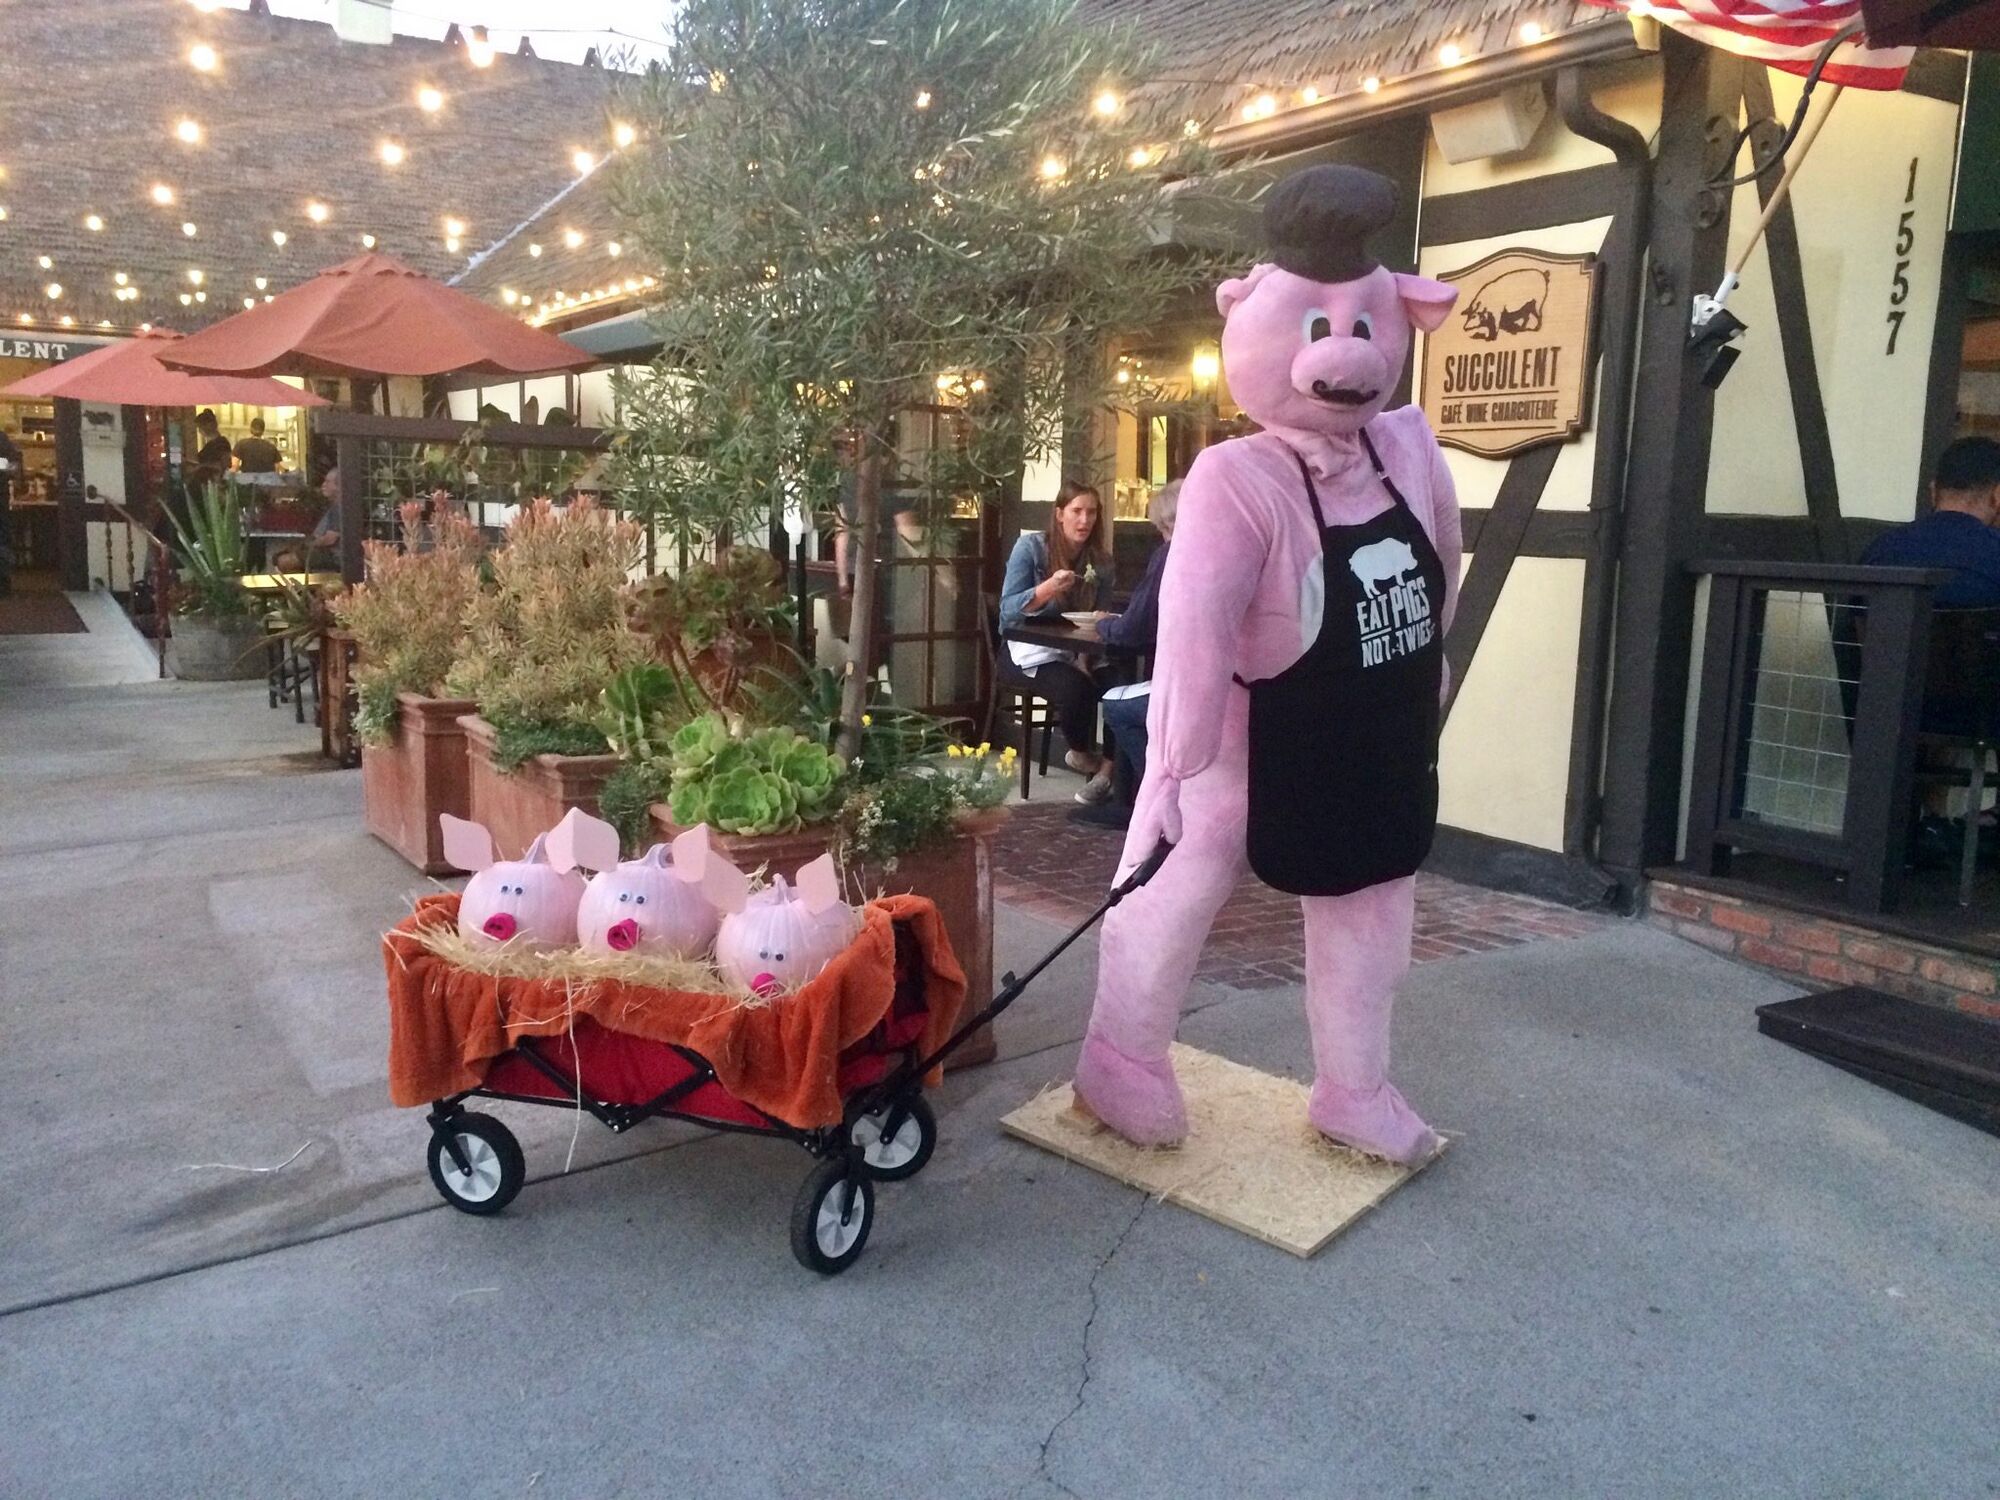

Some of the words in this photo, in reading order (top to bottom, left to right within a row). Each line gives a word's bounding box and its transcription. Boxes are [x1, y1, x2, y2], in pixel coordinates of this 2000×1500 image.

[1886, 157, 1919, 356] 1557
[0, 339, 68, 361] LENT
[1443, 346, 1562, 393] SUCCULENT
[1440, 401, 1463, 424] CAFÉ
[1466, 403, 1489, 423] WINE
[1491, 400, 1558, 422] CHARCUTERIE
[1356, 593, 1390, 635] EAT
[1389, 575, 1431, 628] PIGS
[1361, 635, 1391, 668] NOT
